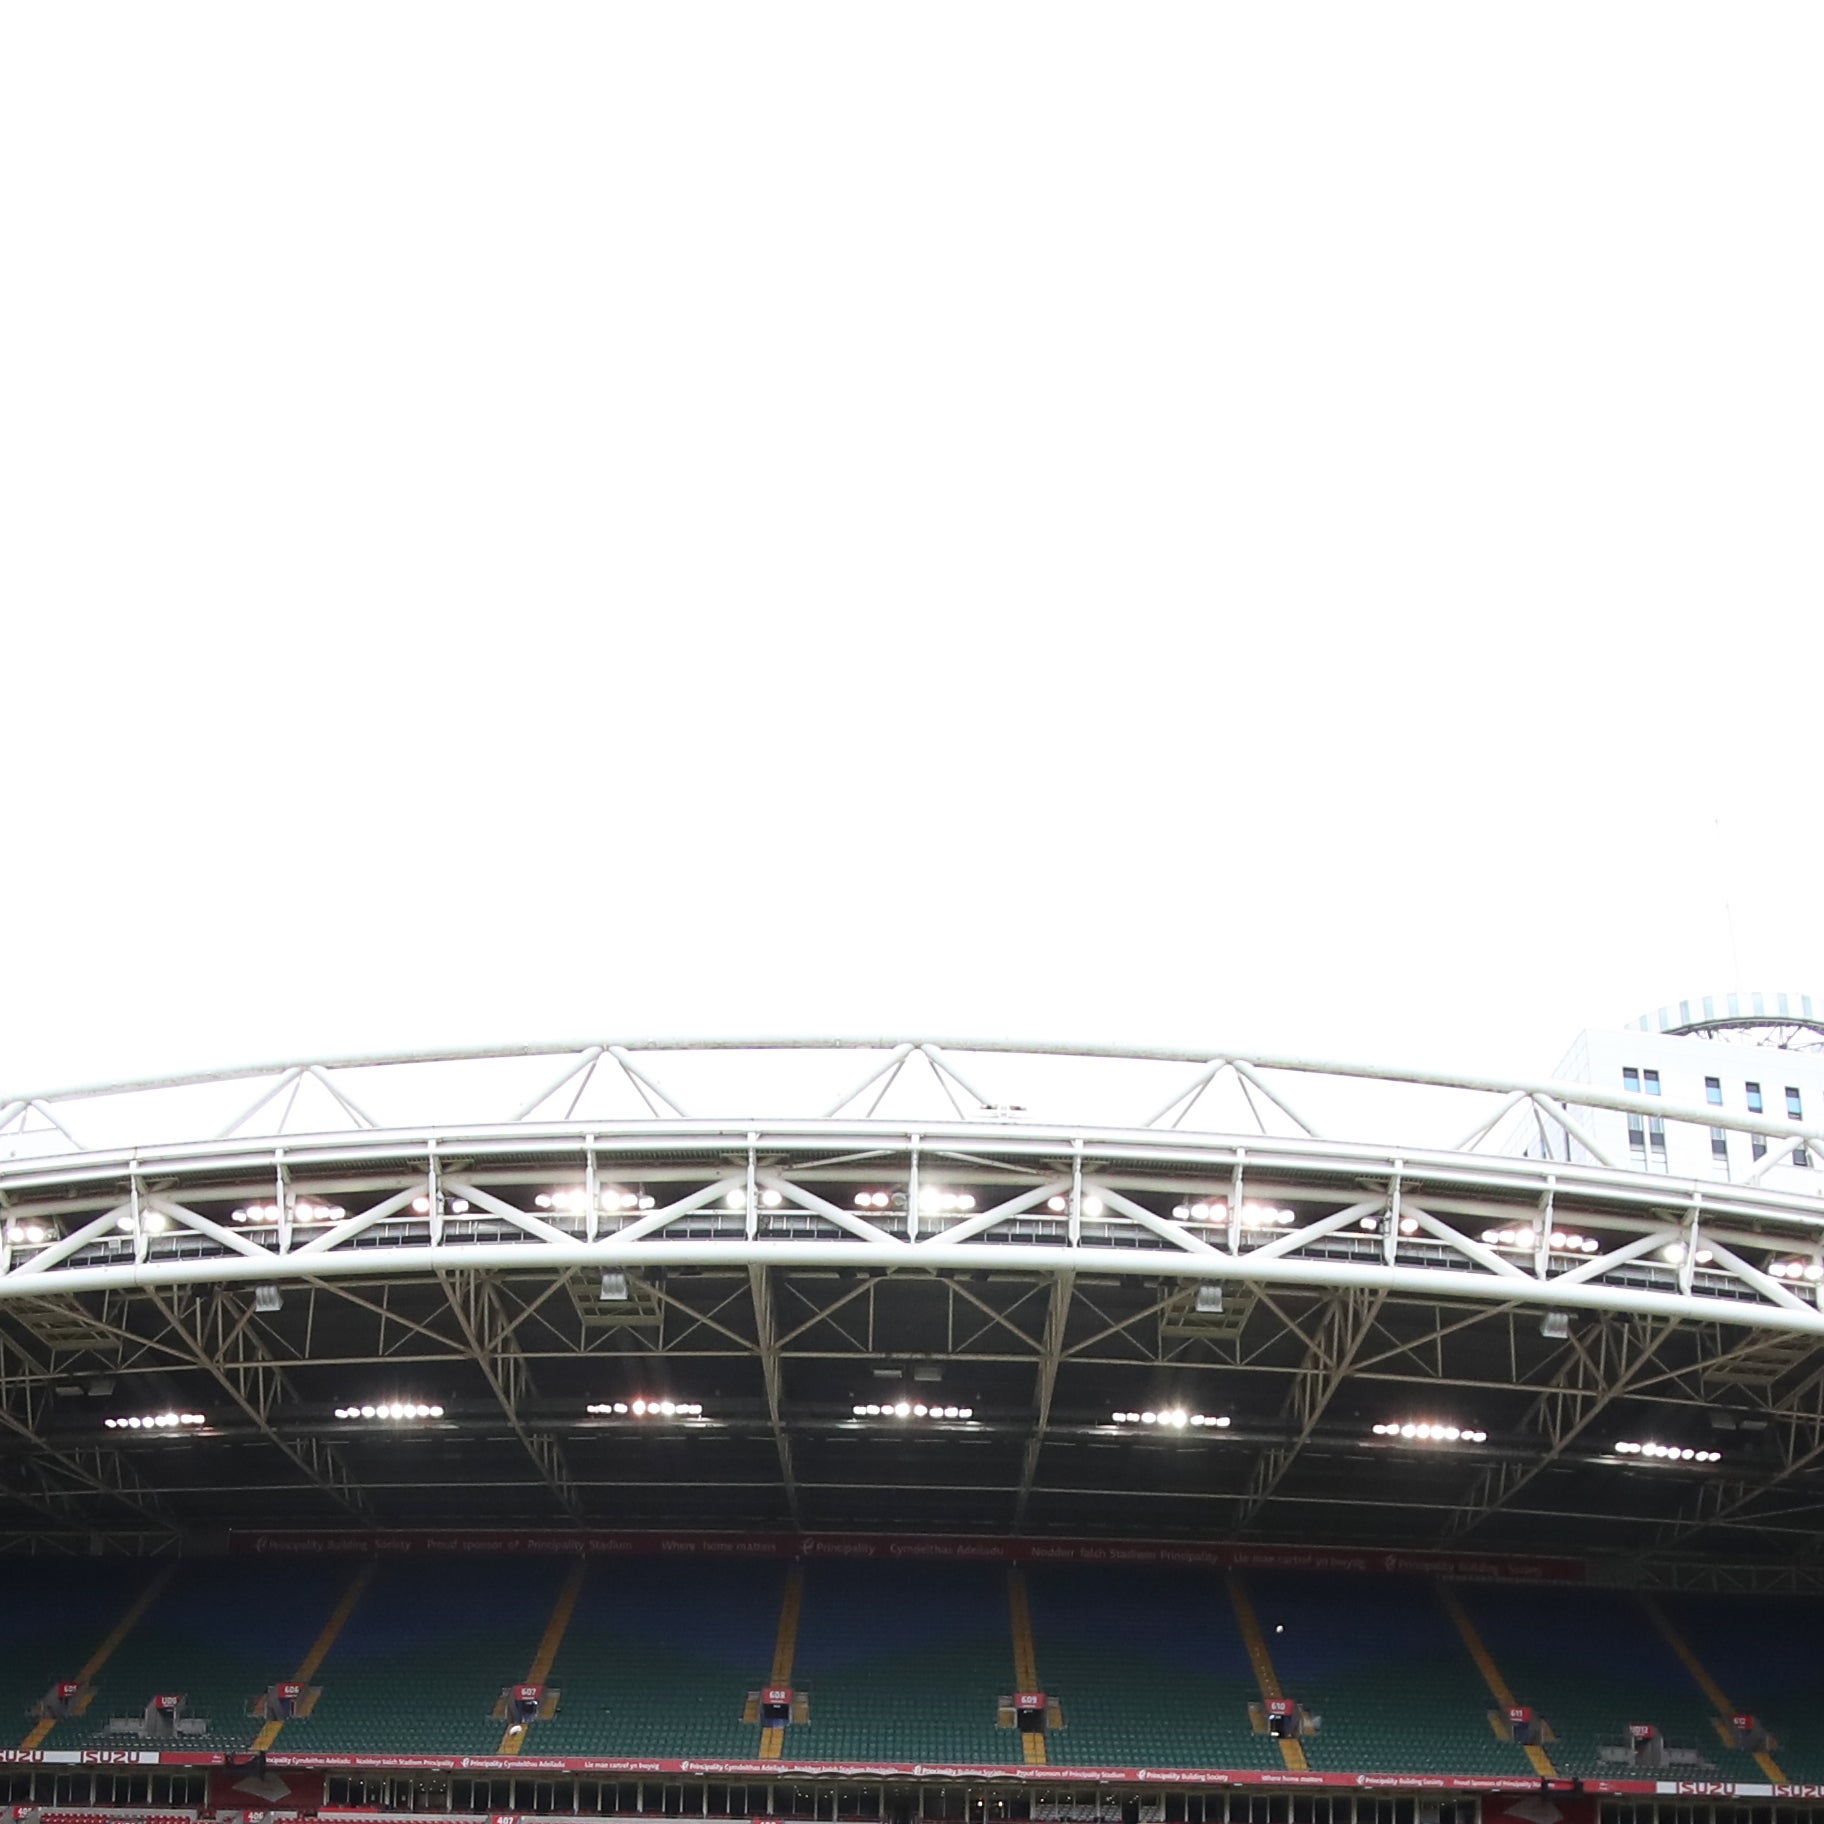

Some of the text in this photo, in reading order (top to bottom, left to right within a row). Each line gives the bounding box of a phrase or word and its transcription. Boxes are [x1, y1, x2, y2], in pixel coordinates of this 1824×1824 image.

[521, 1688, 537, 1696] 607
[80, 1751, 140, 1764] ISUZU
[1679, 1782, 1736, 1795] ISUZU
[497, 1817, 514, 1824] 407
